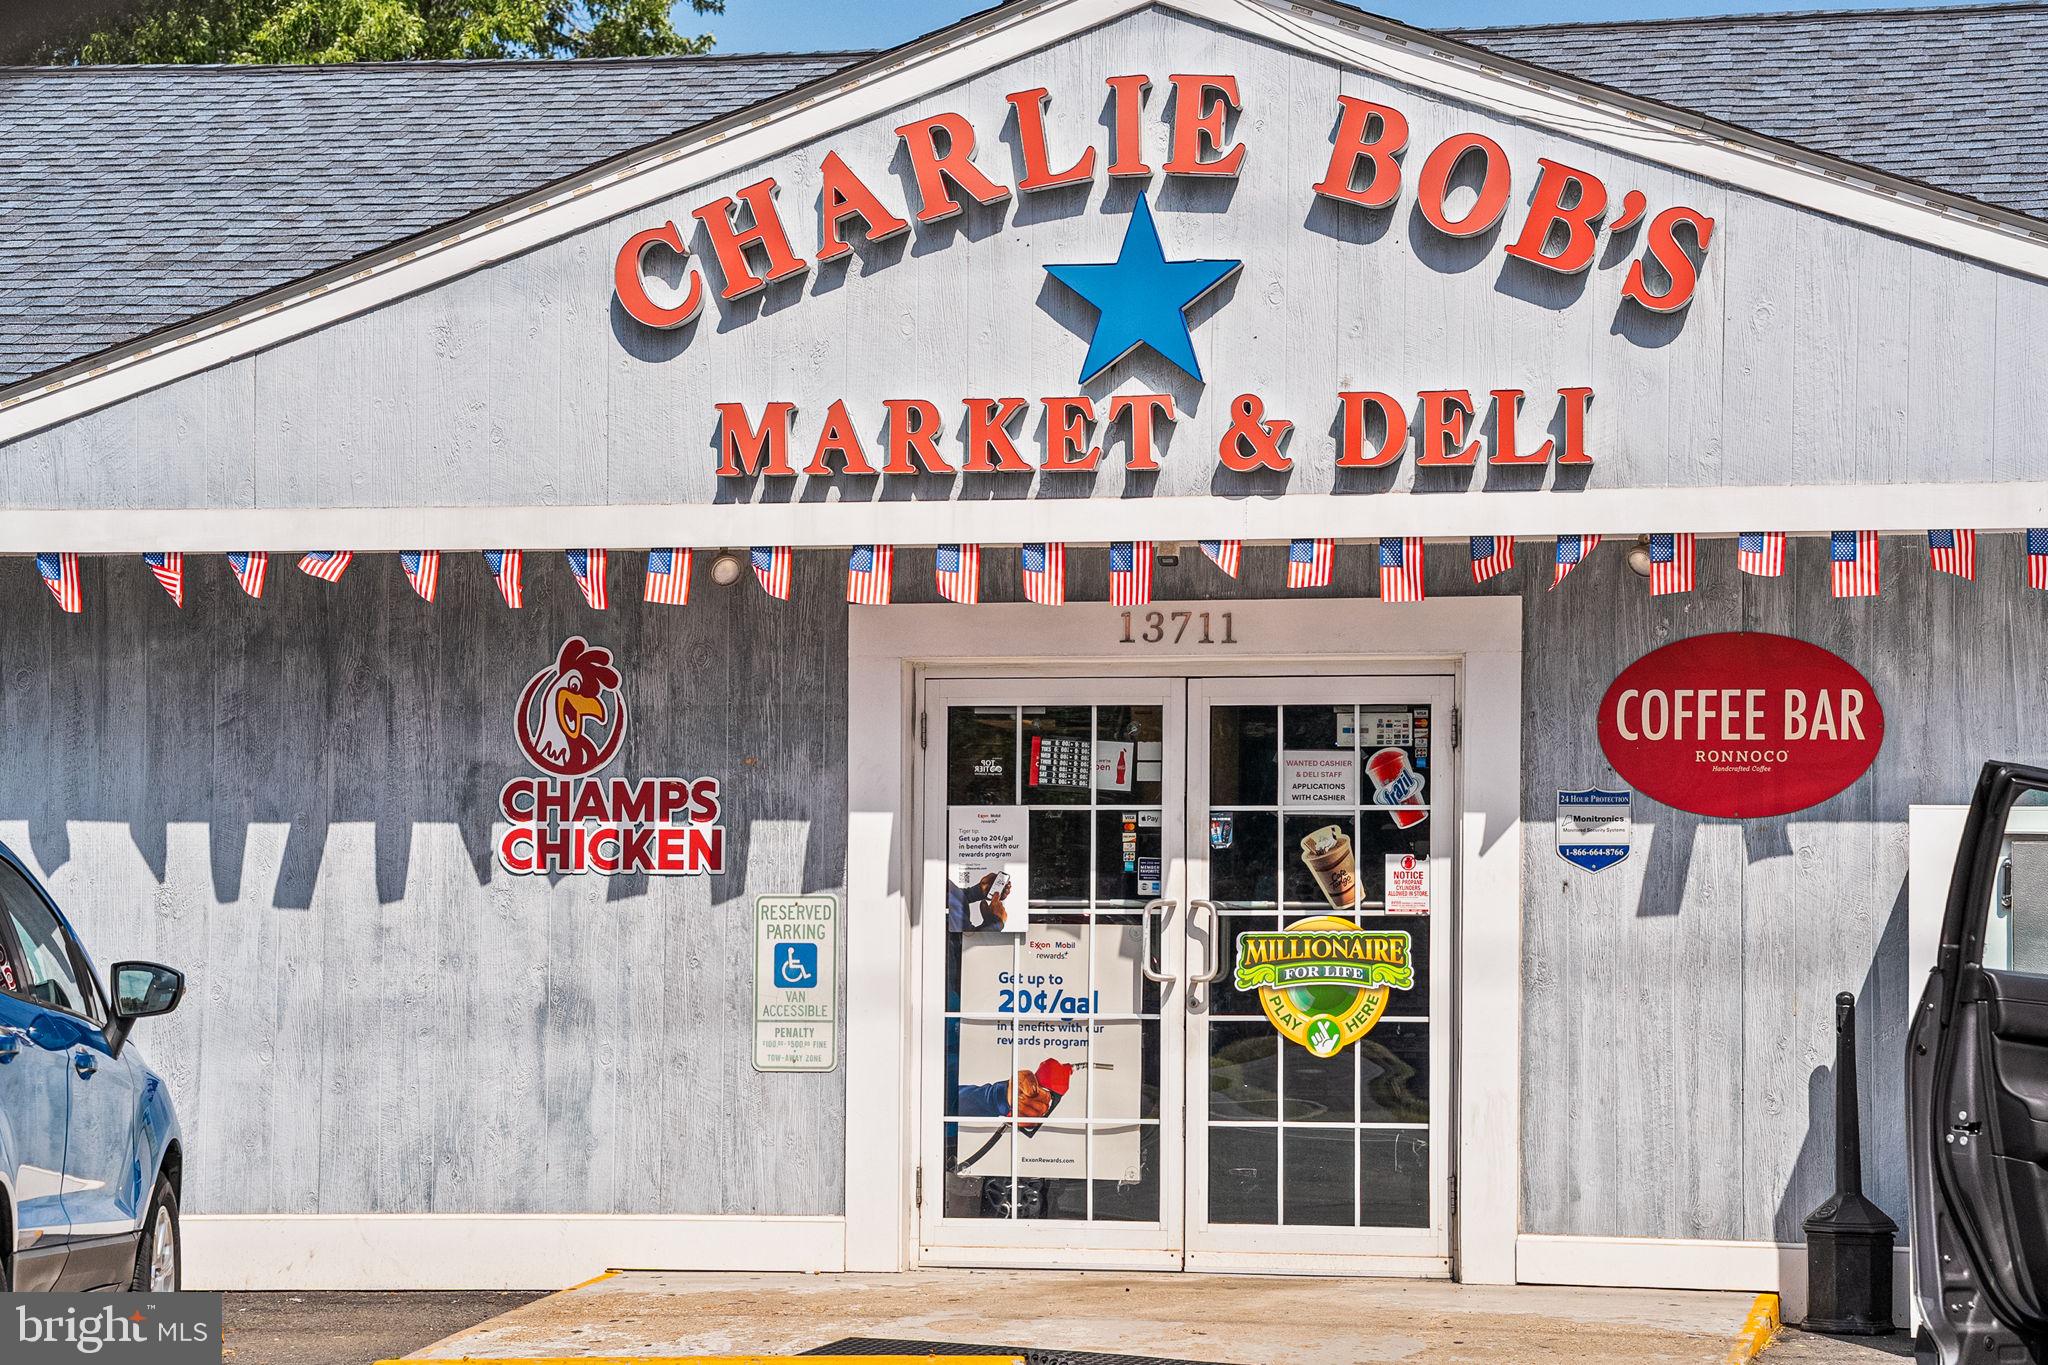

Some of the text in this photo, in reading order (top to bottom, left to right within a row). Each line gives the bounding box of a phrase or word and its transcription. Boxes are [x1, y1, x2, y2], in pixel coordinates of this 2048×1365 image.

[615, 75, 1714, 327] CHARLIE BOB'S
[715, 388, 1592, 476] MARKET & DELI
[1119, 611, 1238, 644] 13711
[1616, 688, 1866, 741] COFFEE BAR
[1695, 750, 1788, 762] RONNOCO
[502, 780, 718, 823] CHAMPS
[1561, 795, 1568, 803] 24
[1591, 795, 1628, 803] PROTECTION
[1147, 815, 1159, 823] Pay
[1573, 815, 1624, 823] Monitronics
[501, 828, 722, 871] CHICKEN
[1566, 848, 1624, 856] 1-866-664-8766
[1393, 871, 1424, 879] NOTICE
[761, 904, 832, 920] RESERVED
[766, 924, 826, 940] PARKING
[1030, 941, 1051, 950] Exxon
[1244, 938, 1404, 966] MILLIONAIRE
[1284, 965, 1364, 980] FOR LIFE
[1028, 976, 1045, 988] up
[1049, 974, 1063, 985] to
[785, 990, 806, 1003] VAN
[762, 1004, 828, 1017] ACCESSIBLE
[1269, 994, 1303, 1032] PLAY
[1345, 994, 1379, 1033] HERE
[774, 1027, 815, 1038] PENALTY
[997, 1020, 1007, 1030] in
[1059, 1021, 1082, 1032] with
[813, 1040, 828, 1048] FINE
[1044, 1038, 1089, 1049] program
[805, 1054, 822, 1062] ZONE
